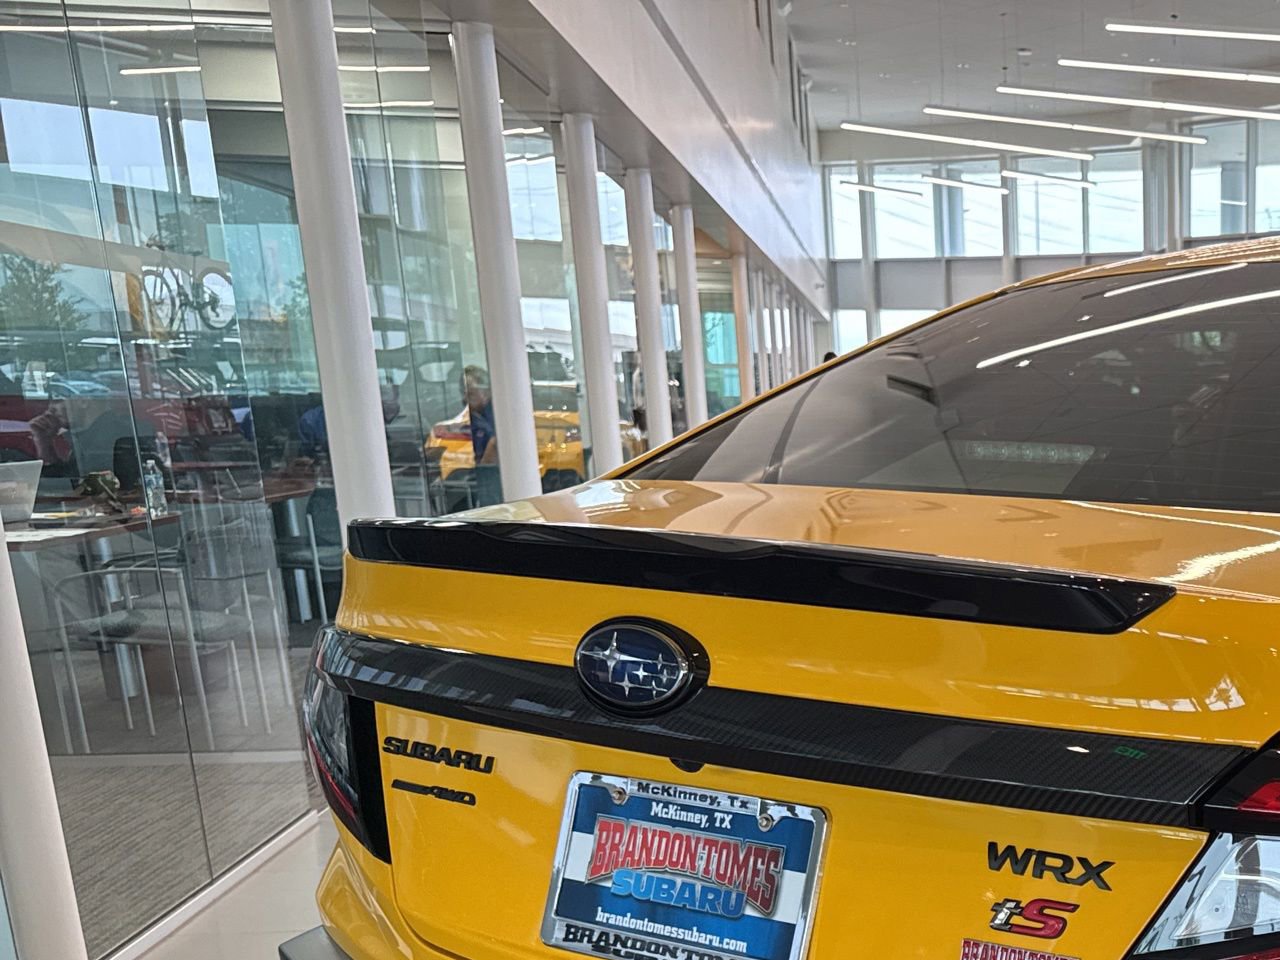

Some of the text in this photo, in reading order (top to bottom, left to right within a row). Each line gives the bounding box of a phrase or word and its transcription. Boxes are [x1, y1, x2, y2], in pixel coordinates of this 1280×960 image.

[382, 736, 495, 774] SUBARU
[636, 781, 722, 807] McKinney,
[650, 801, 733, 829] McKinney, TX
[588, 818, 784, 913] BRANDON TOMES
[987, 841, 1116, 891] WRX
[610, 869, 746, 916] SUBARU
[595, 907, 748, 954] brandontomessubaru.com
[989, 898, 1080, 939] tS
[562, 923, 680, 960] BRANDON
